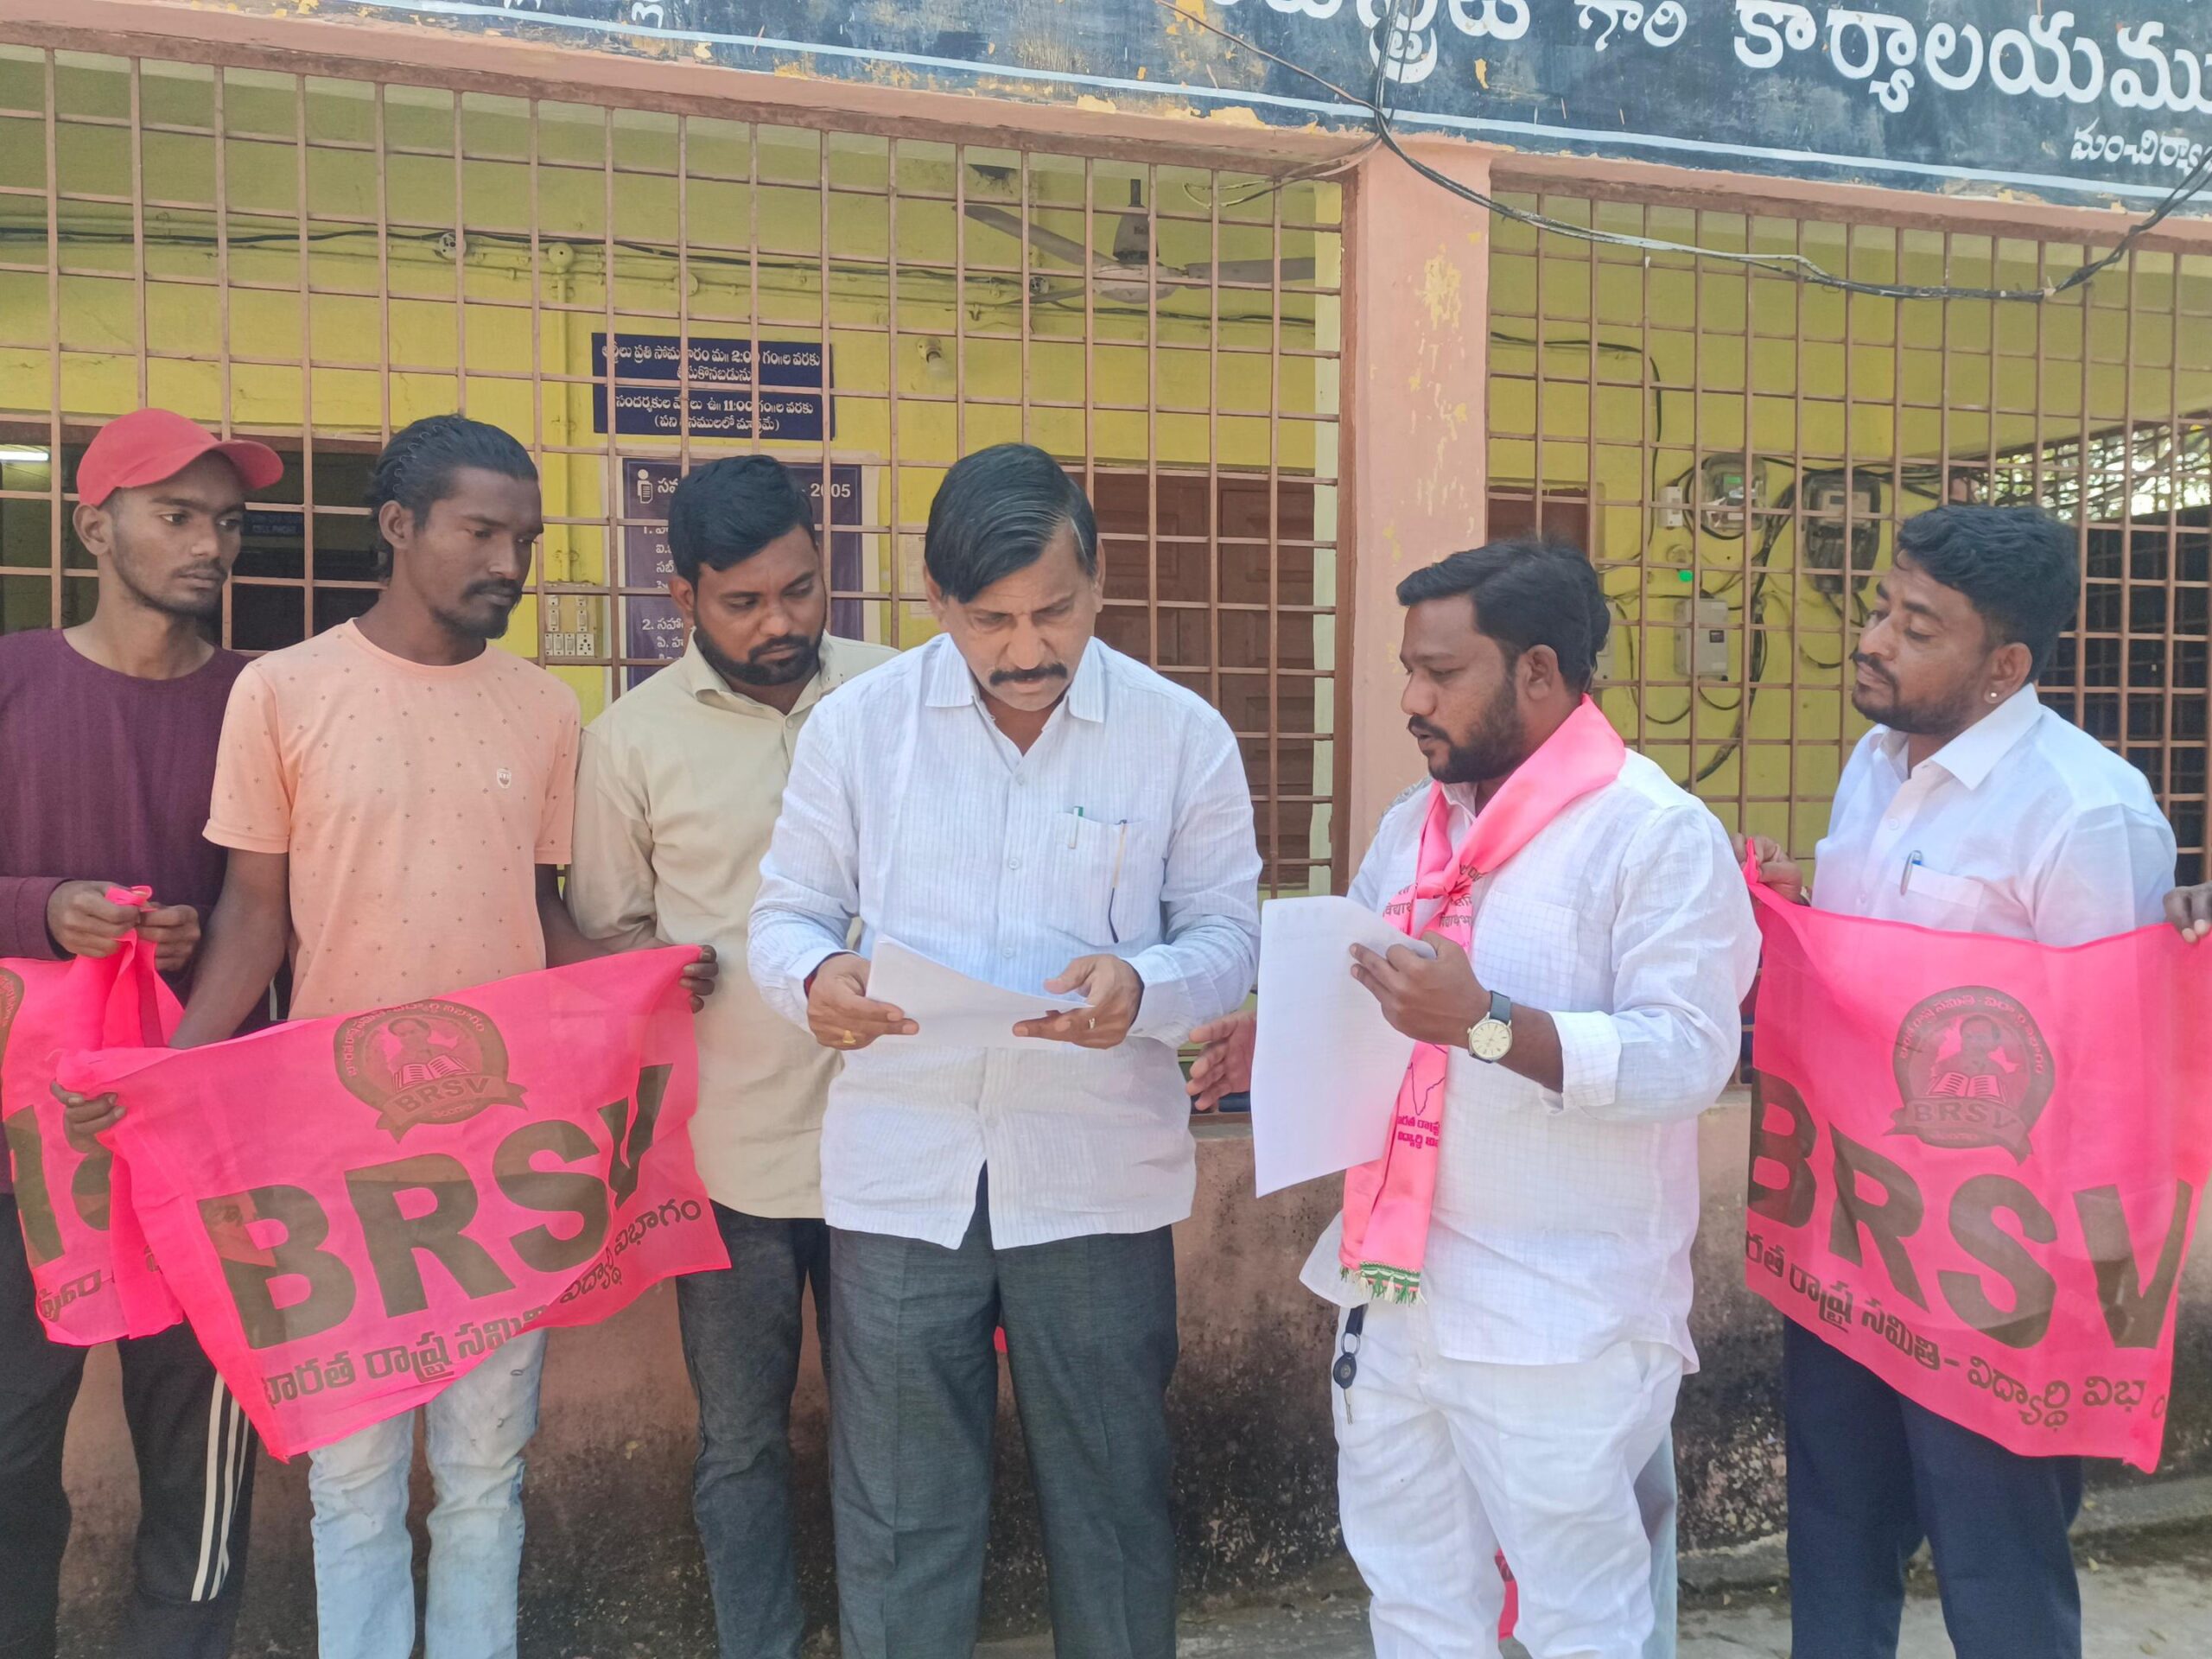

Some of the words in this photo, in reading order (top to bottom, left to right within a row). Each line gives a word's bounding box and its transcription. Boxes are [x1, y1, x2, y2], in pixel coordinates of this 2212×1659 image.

[731, 349, 760, 364] 2:0
[792, 353, 820, 366] వరకు
[642, 619, 654, 631] 2.
[393, 1077, 489, 1114] BRSV
[1912, 1101, 2018, 1128] BRSV
[197, 1062, 674, 1351] BRSV
[1746, 1065, 2194, 1350] BRSV
[362, 1330, 455, 1384] రాష్ట్ర
[613, 1198, 702, 1256] విభాగం
[1789, 1262, 1854, 1334] రాష్ట్ర
[1967, 1355, 2070, 1433] విద్యార్థి
